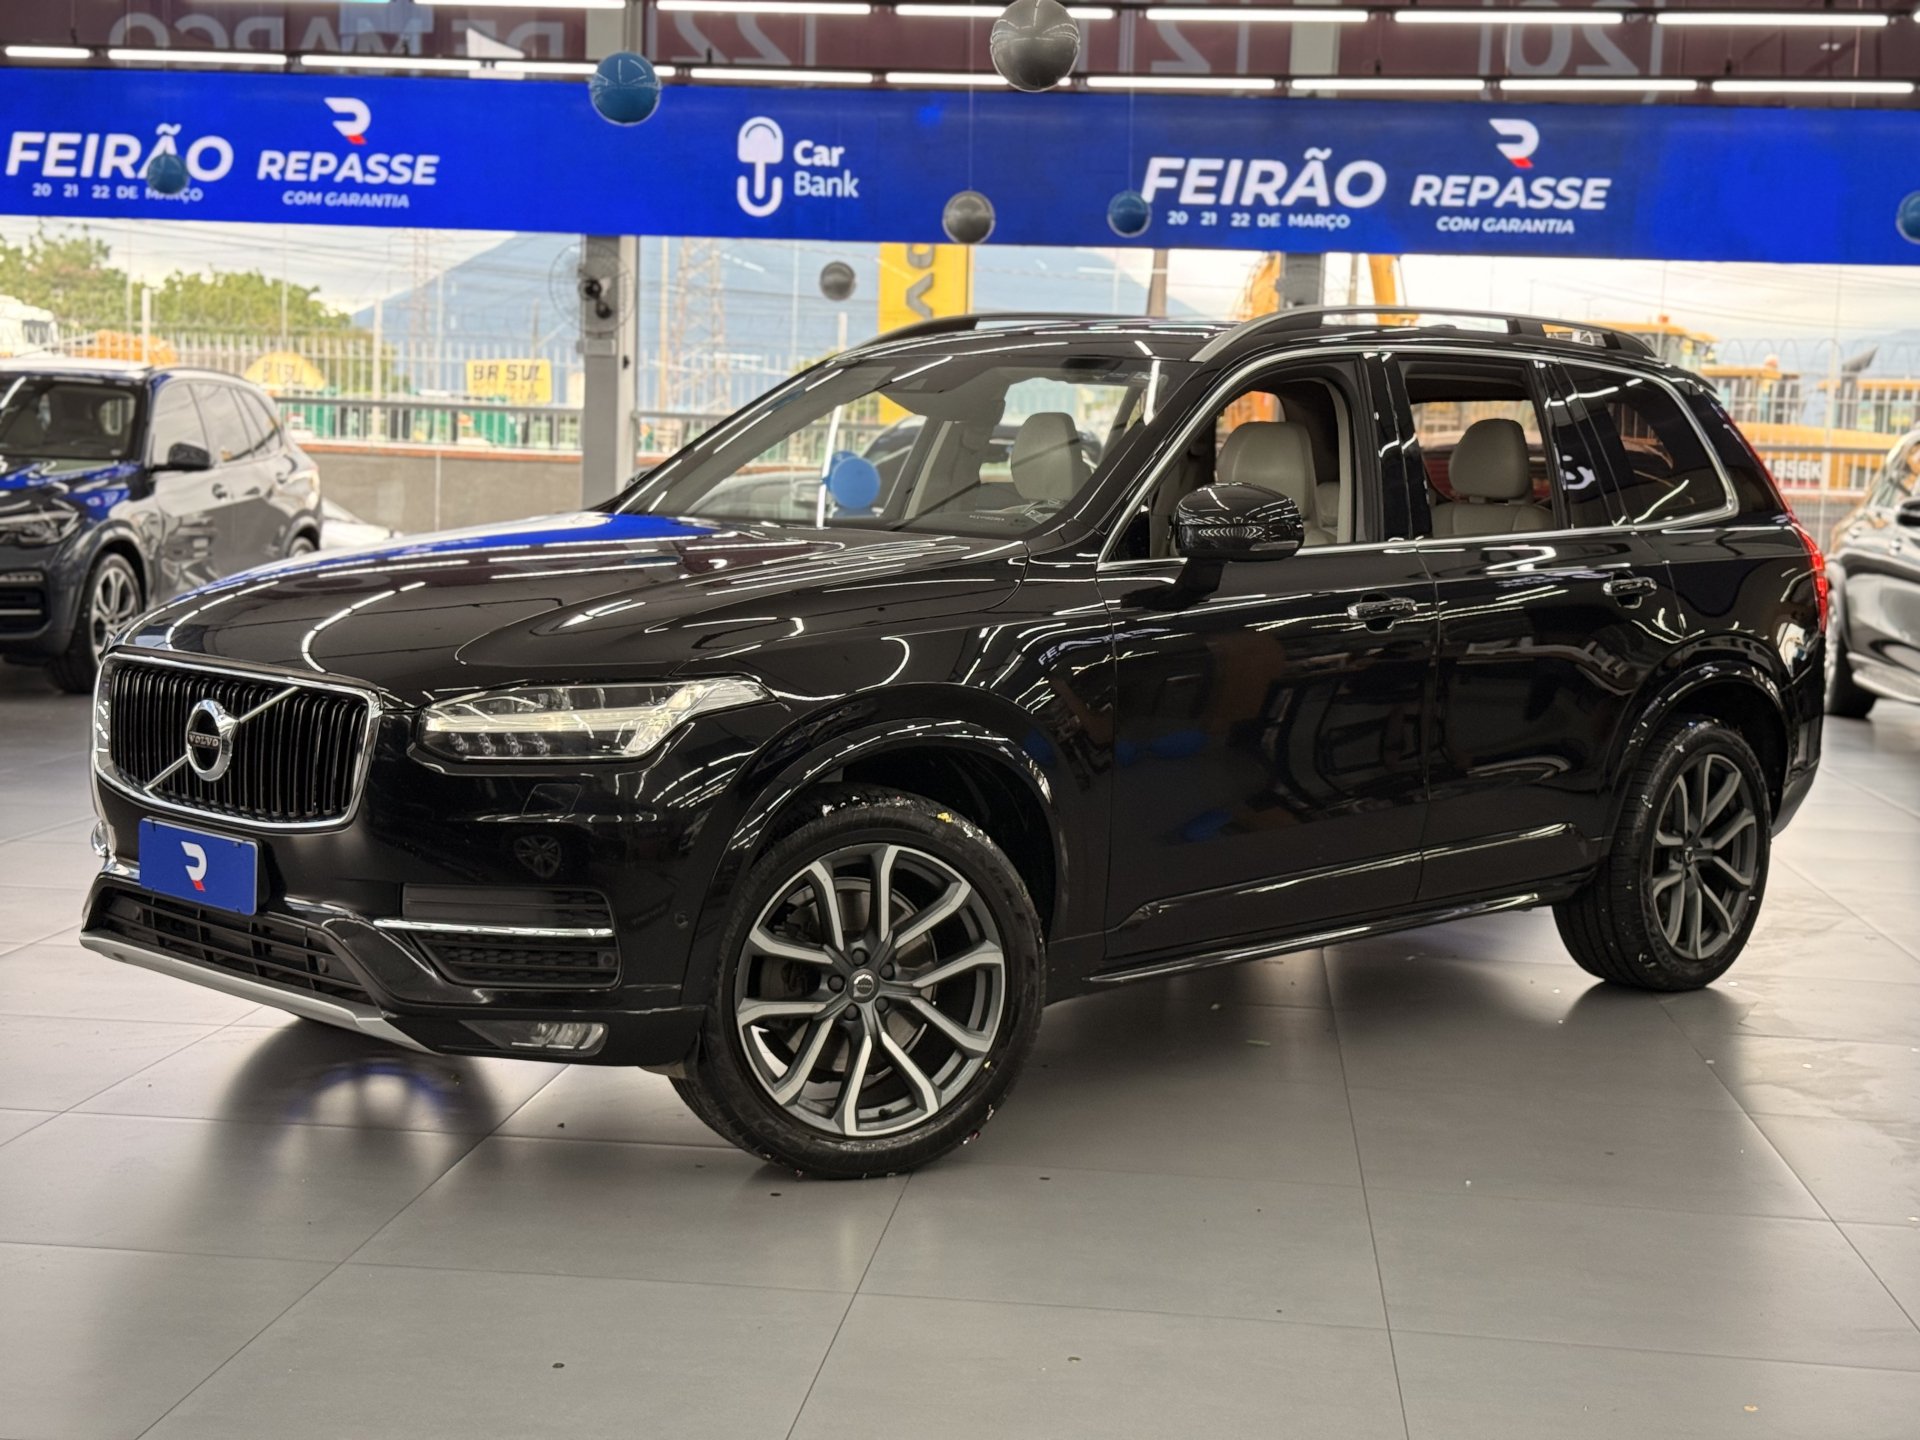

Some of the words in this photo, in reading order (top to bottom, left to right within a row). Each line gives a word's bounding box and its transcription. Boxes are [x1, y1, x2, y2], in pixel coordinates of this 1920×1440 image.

[793, 140, 845, 167] Car
[257, 150, 440, 185] REPASSE
[1140, 147, 1387, 208] FEIRÃO
[32, 182, 53, 197] 20
[63, 183, 79, 198] 21
[92, 184, 111, 199] 22
[116, 185, 139, 200] DE
[145, 187, 204, 204] MÇO
[793, 169, 859, 198] Bank
[1410, 174, 1612, 210] REPASSE
[282, 190, 322, 206] COM
[324, 191, 410, 208] GARANTIA
[1167, 211, 1189, 225] 20
[1200, 211, 1218, 226] 21
[1231, 212, 1251, 227] 22
[1257, 213, 1281, 228] DE
[1288, 213, 1351, 231] MARÇO
[1436, 216, 1480, 232] COM
[1481, 217, 1575, 234] GARANTIA
[189, 734, 219, 747] VOLVO
